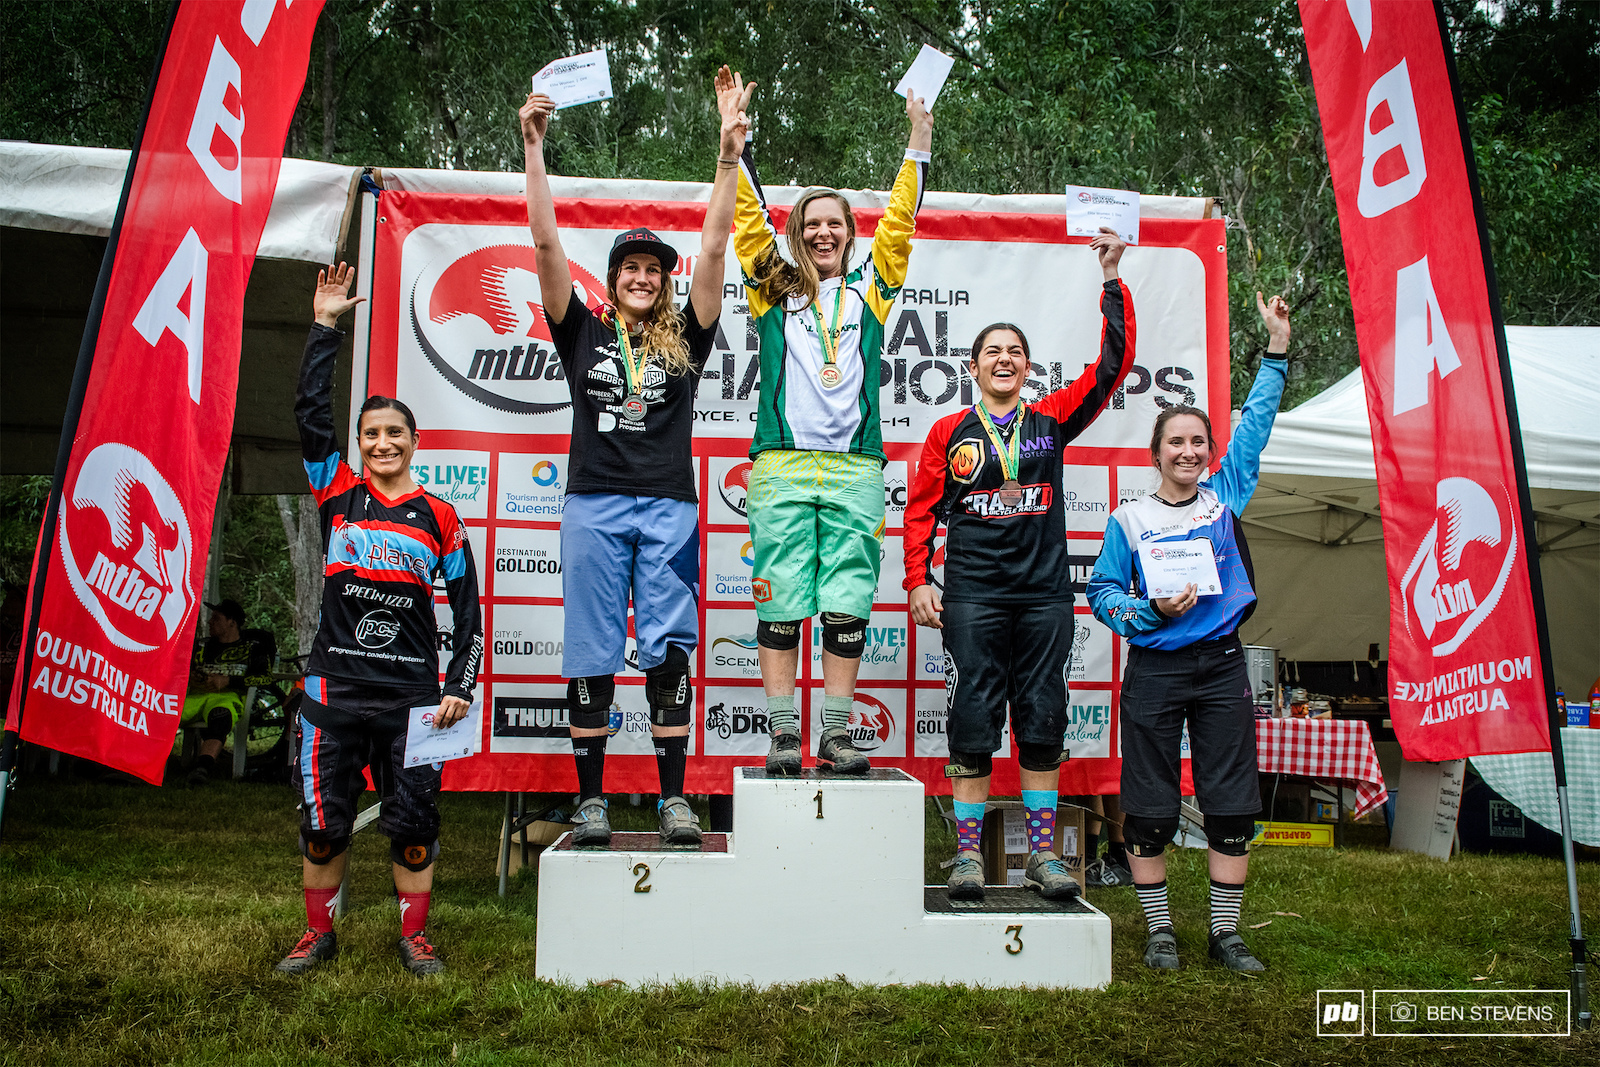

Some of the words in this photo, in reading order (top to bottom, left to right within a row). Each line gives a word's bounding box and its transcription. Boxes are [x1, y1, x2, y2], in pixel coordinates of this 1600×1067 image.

[587, 370, 624, 386] THREDBO
[618, 424, 647, 432] Prospect
[435, 465, 487, 486] LIVE!
[506, 493, 537, 502] Tourism
[539, 494, 556, 502] and
[505, 502, 564, 515] Queensl
[1067, 505, 1115, 516] VERSITY
[368, 538, 431, 579] planet
[497, 549, 547, 557] DESTINATION
[715, 573, 747, 582] Tourism
[86, 551, 163, 621] mtba
[494, 631, 511, 639] CITY
[512, 631, 522, 639] OF
[328, 645, 366, 657] progressive
[367, 650, 397, 662] coaching
[397, 654, 426, 664] systems
[494, 641, 564, 656] GOLDCOA
[715, 655, 759, 666] SCENI
[36, 629, 130, 698] OUNTAIN
[132, 680, 179, 716] BIKE
[33, 667, 150, 736] AUSTRALIA
[504, 708, 570, 728] THUL
[732, 706, 754, 714] MTB
[813, 789, 824, 819] 1
[632, 862, 652, 893] 2
[1005, 924, 1023, 955] 3
